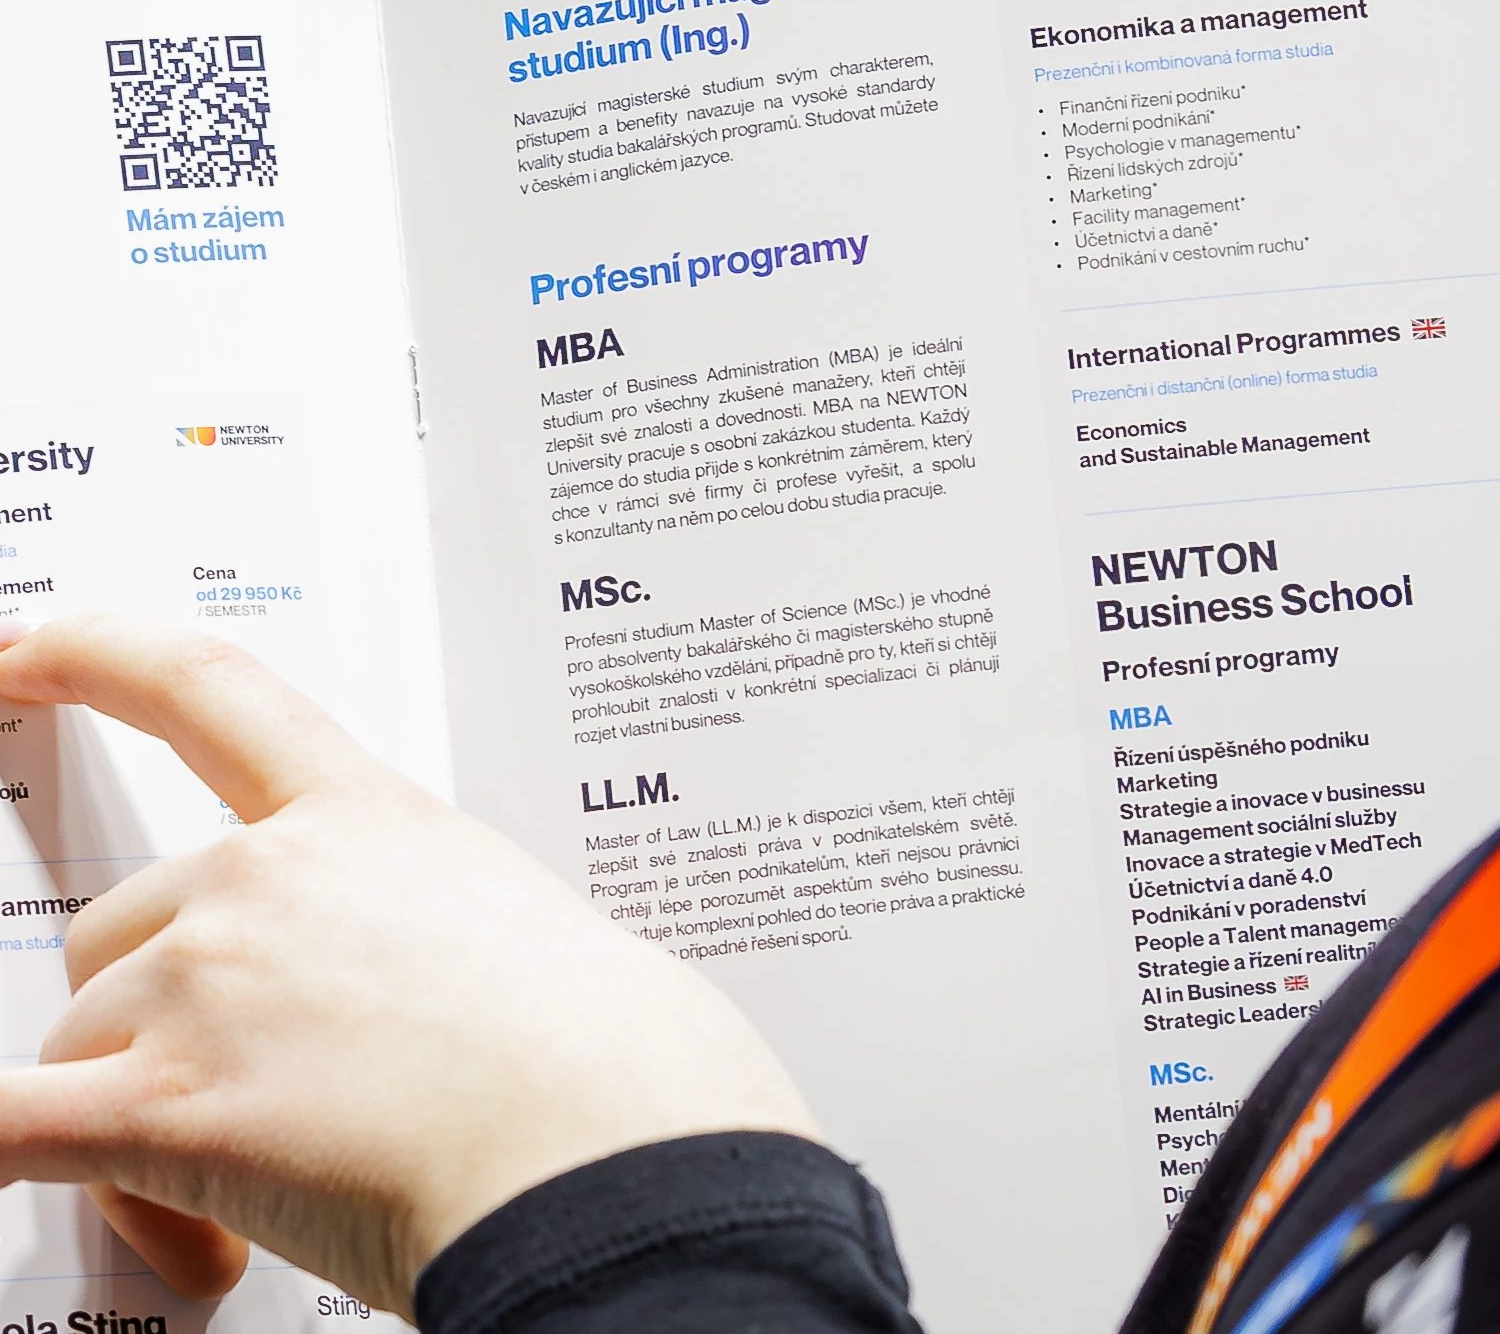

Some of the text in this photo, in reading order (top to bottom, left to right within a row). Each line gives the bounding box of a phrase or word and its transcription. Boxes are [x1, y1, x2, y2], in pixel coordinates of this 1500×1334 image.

[1030, 0, 1368, 48] Ekonomika a management
[509, 13, 749, 82] studium (Ing.)
[520, 152, 733, 194] v českém i anglickém jazyce.
[127, 206, 284, 232] Mám zájem
[1073, 208, 1130, 226] Facility
[131, 239, 266, 264] o studium
[531, 235, 869, 305] Profesní programy
[537, 328, 625, 368] MBA
[1068, 326, 1400, 369] International Programmes
[220, 425, 270, 434] NEWTON
[221, 436, 283, 445] UNIVERSITY
[1077, 419, 1186, 441] Economics
[1080, 428, 1370, 468] and Sustainable Management
[193, 567, 236, 580] Cena
[1092, 540, 1278, 586] NEWTON
[196, 587, 302, 601] od 29 950 Kč
[561, 576, 650, 612] MSc.
[1097, 575, 1413, 632] Business School
[1103, 647, 1339, 682] Profesní programy
[1110, 705, 1172, 730] MBA
[1114, 731, 1369, 767] Řízení úspěšného podniku
[581, 773, 679, 812] LL.M.
[1117, 772, 1217, 793] Marketing
[1150, 1062, 1213, 1085] MSc.
